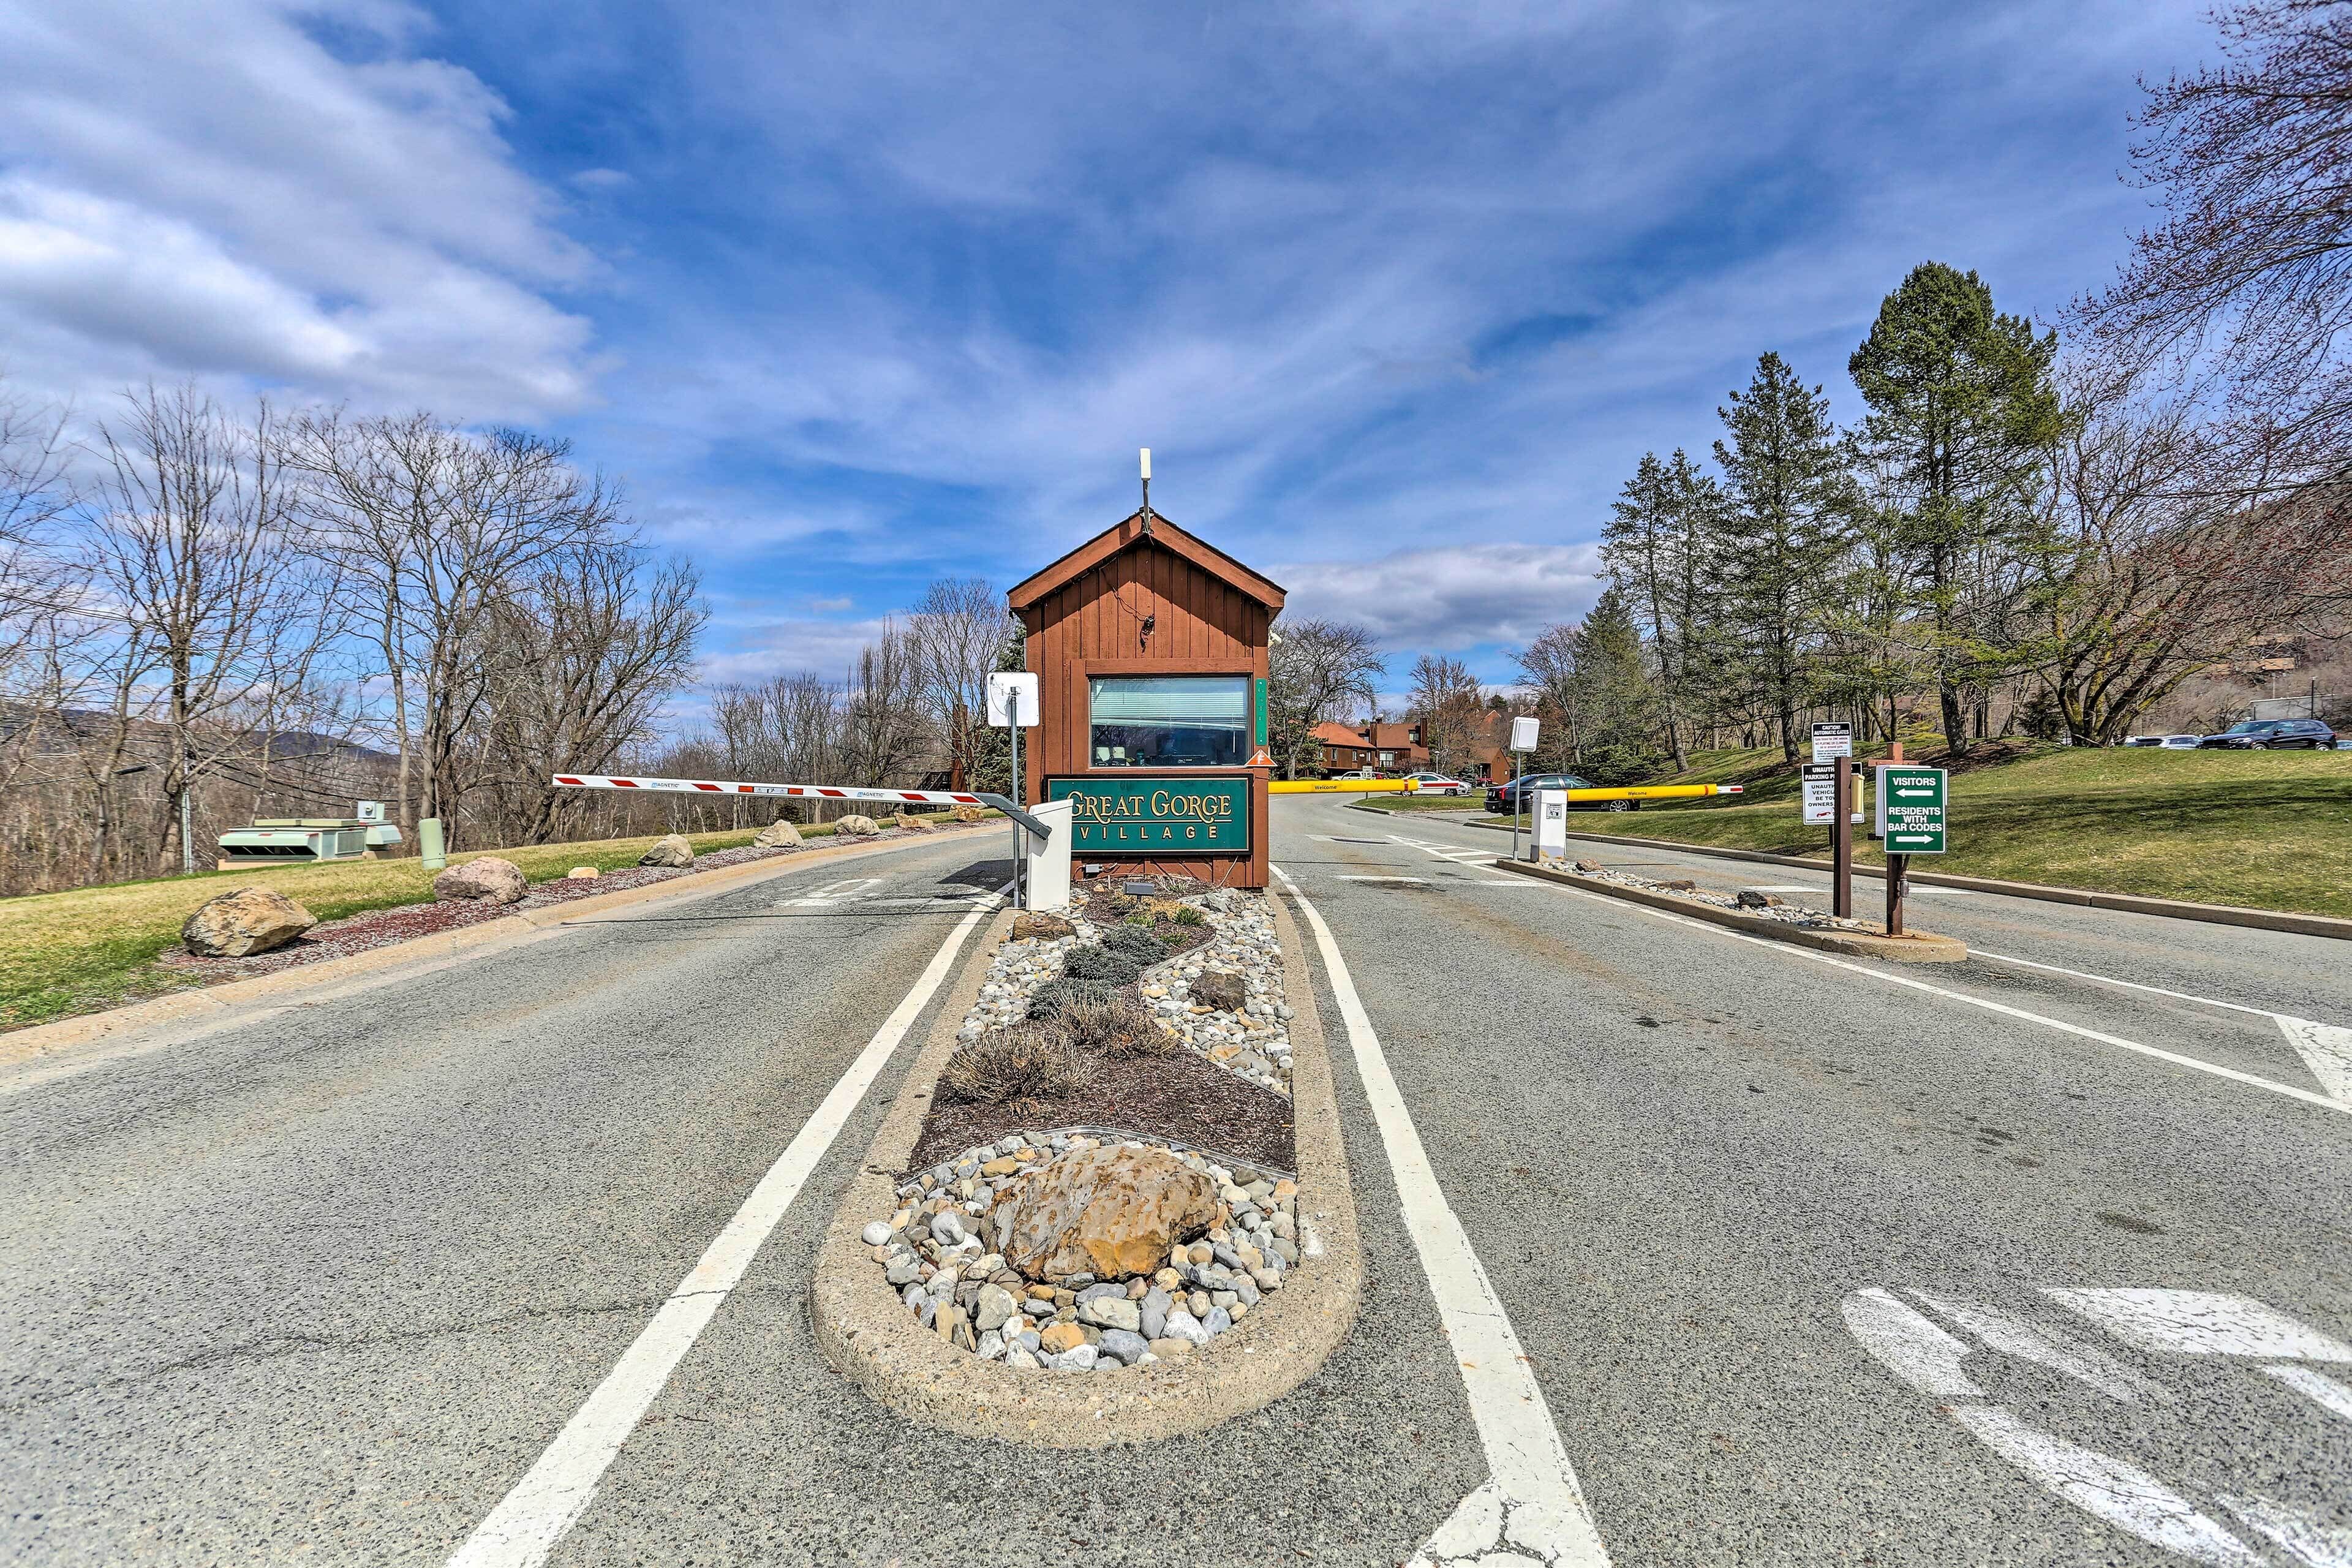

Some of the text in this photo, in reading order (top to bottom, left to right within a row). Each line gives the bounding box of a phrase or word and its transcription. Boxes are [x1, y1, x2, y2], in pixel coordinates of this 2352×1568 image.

[1892, 777, 1936, 786] VISITORS
[1067, 790, 1232, 824] GREAT GORGE
[1888, 807, 1941, 816] RESIDENTS
[1909, 823, 1942, 832] CODES
[1080, 826, 1218, 840] VILLAGE
